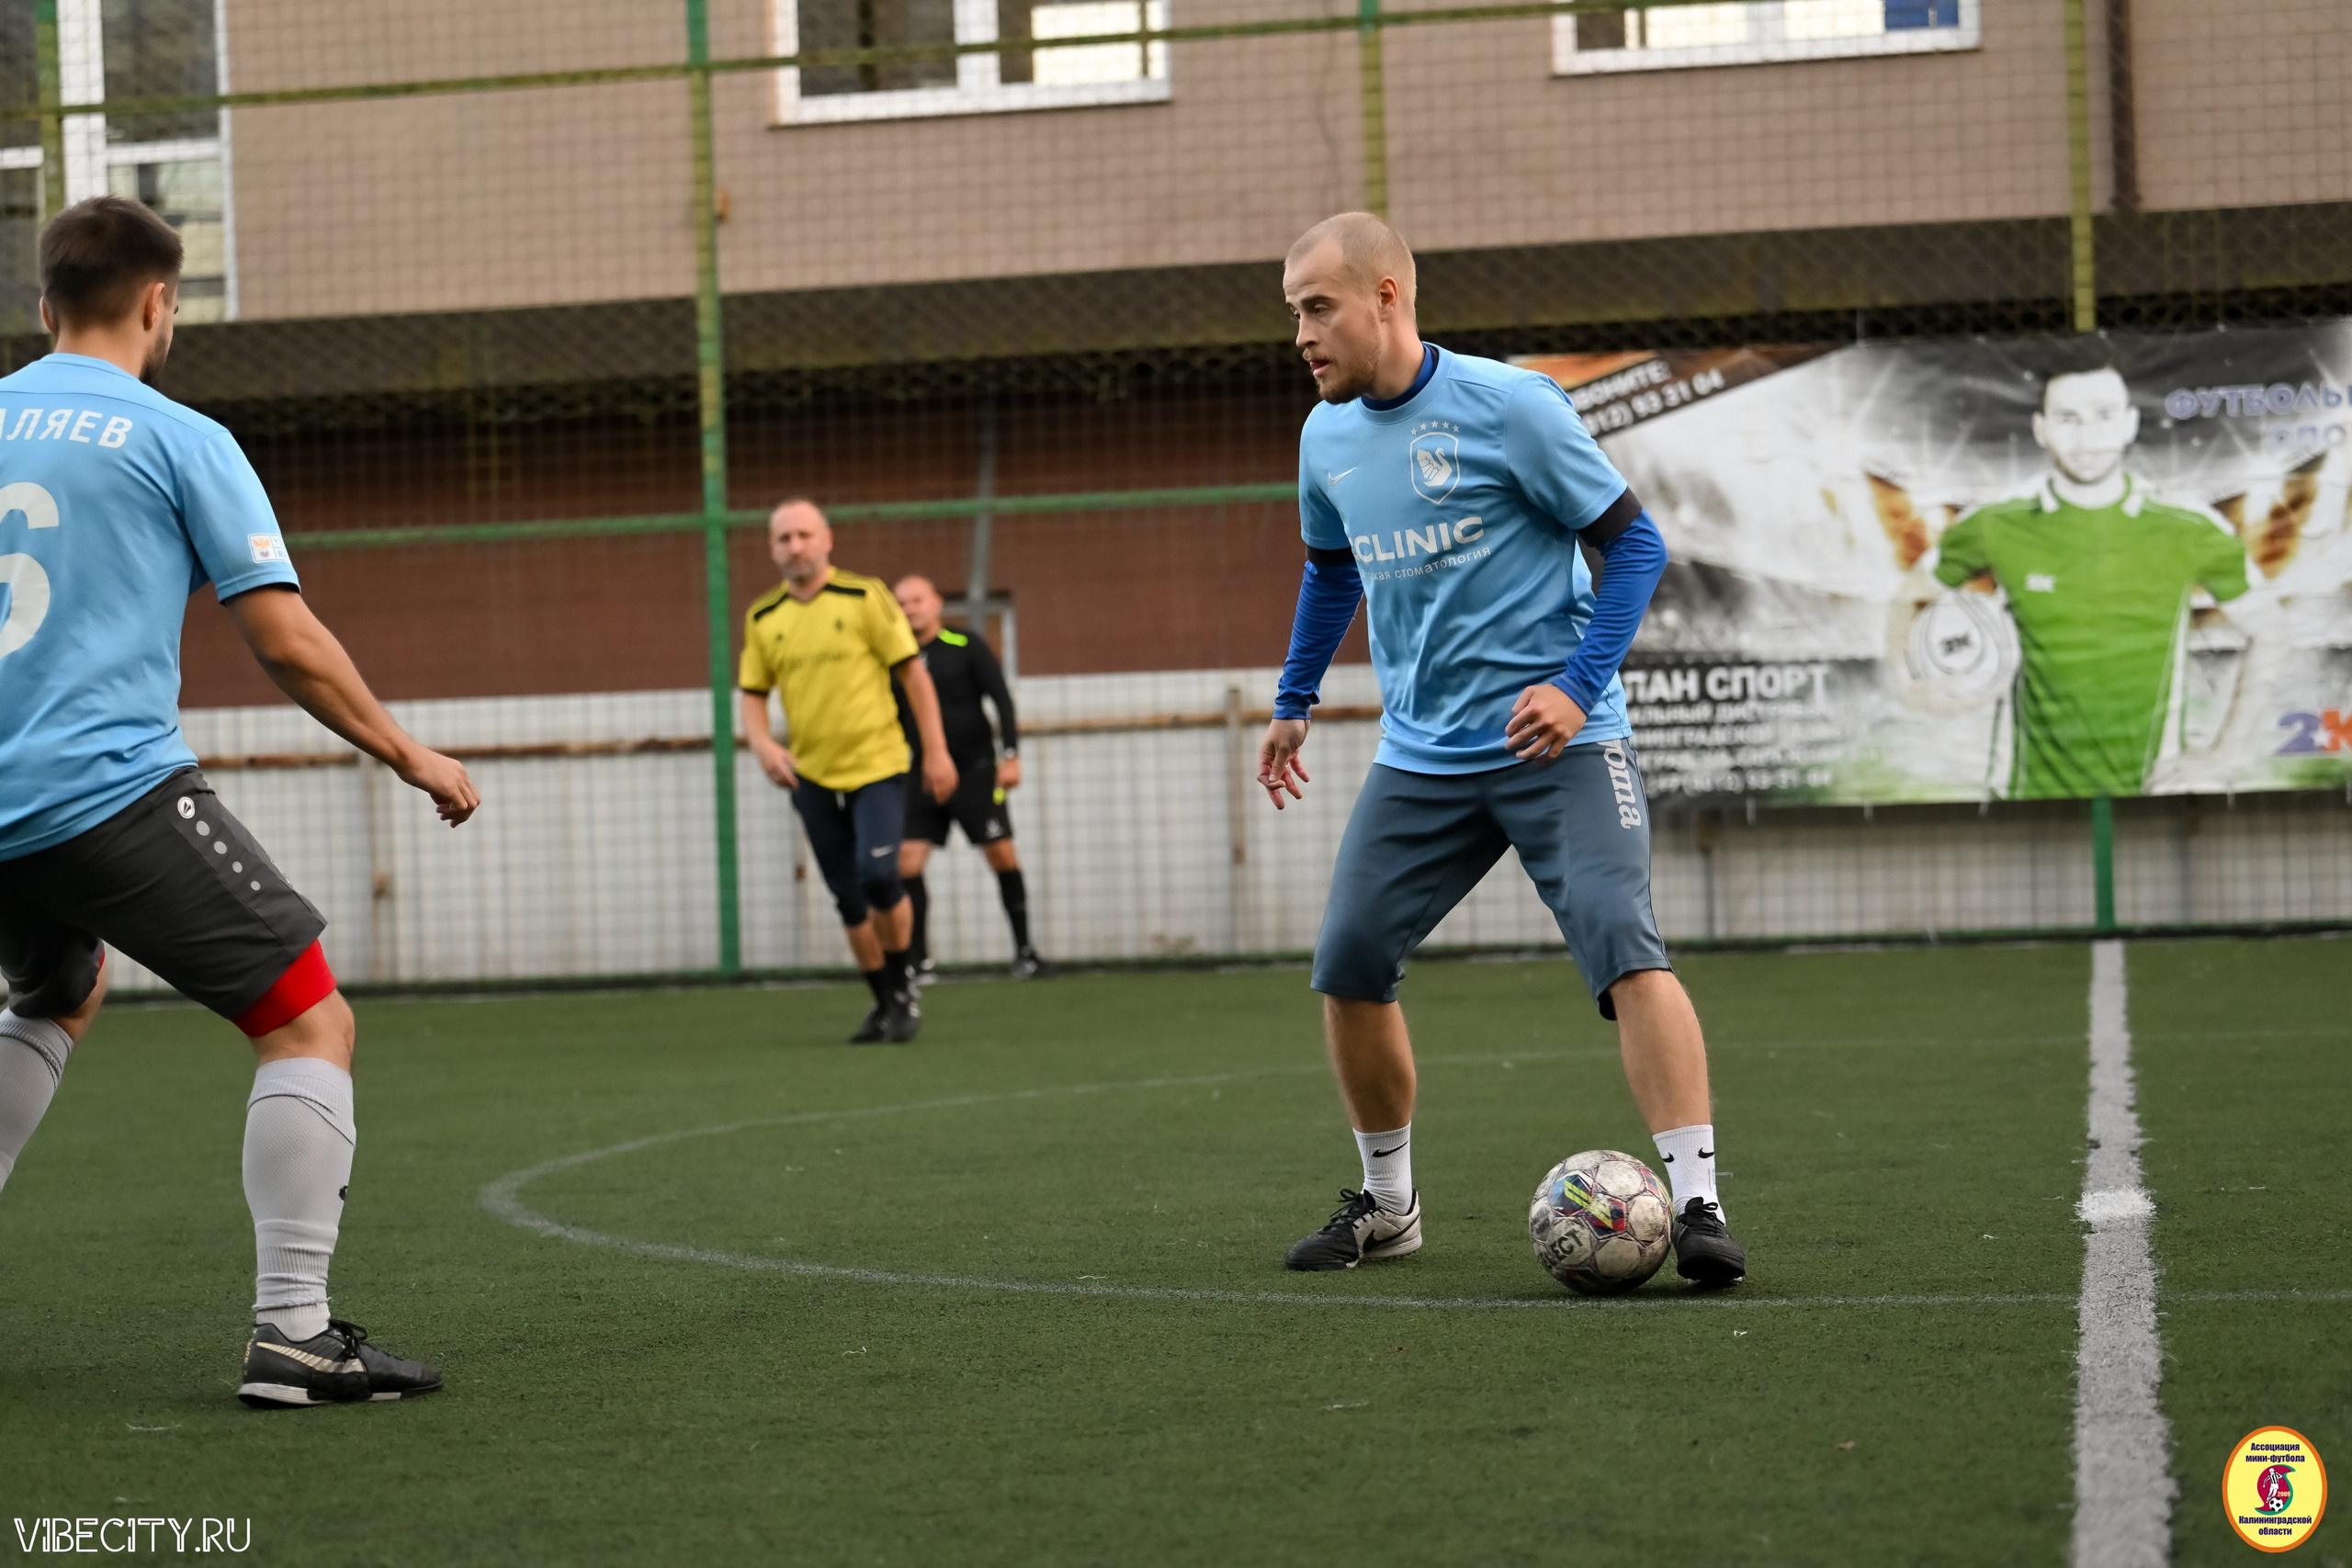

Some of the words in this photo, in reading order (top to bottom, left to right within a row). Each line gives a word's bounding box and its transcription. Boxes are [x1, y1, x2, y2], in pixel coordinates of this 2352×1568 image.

[2165, 382, 2352, 420] ФУТБОЛЬ
[0, 409, 133, 448] ЛЯЕВ
[0, 481, 59, 660] 6
[1394, 547, 1491, 579] стоматология
[1705, 662, 1831, 701] СПОРТ
